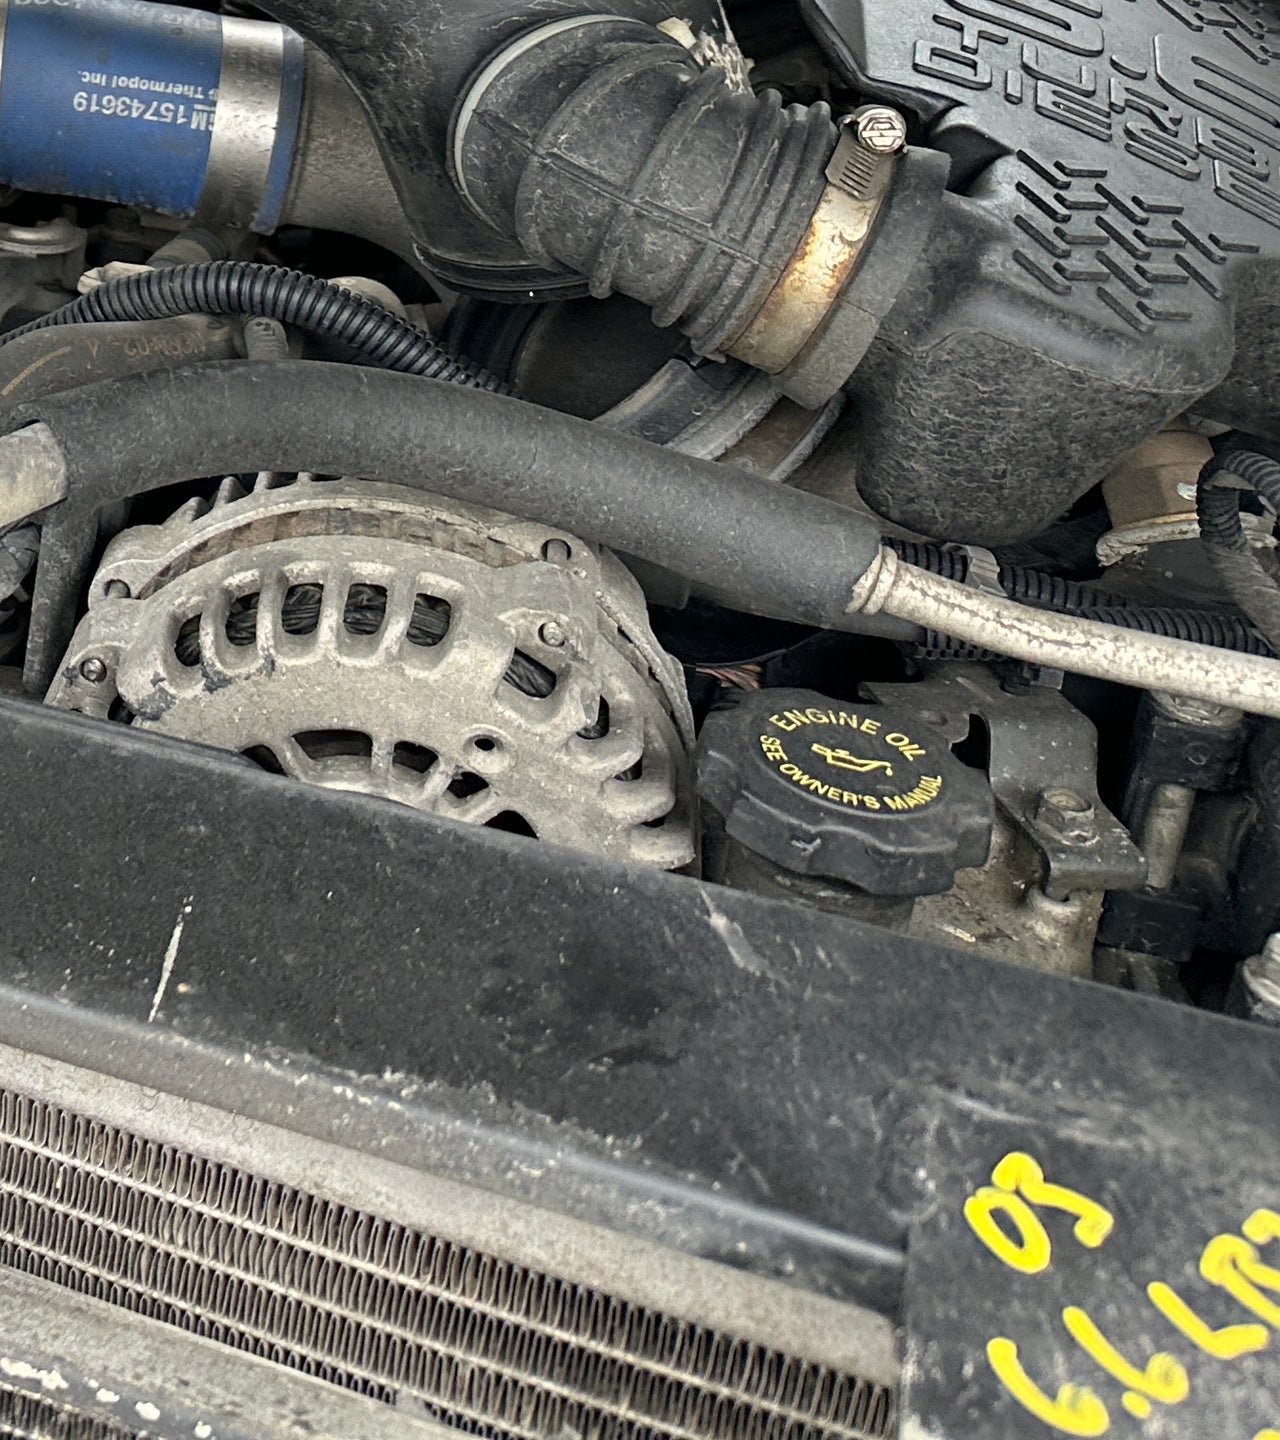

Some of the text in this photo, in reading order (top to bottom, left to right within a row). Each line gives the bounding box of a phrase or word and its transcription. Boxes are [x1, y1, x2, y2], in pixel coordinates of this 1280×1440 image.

[77, 69, 108, 87] Inc.
[111, 74, 204, 100] Thermopol
[933, 13, 1280, 181] TURB
[73, 90, 188, 125] 15743619
[768, 707, 927, 763] ENGINE OIL
[759, 734, 944, 812] SEE OWNER'S MANUAL
[963, 1150, 1116, 1275] 03
